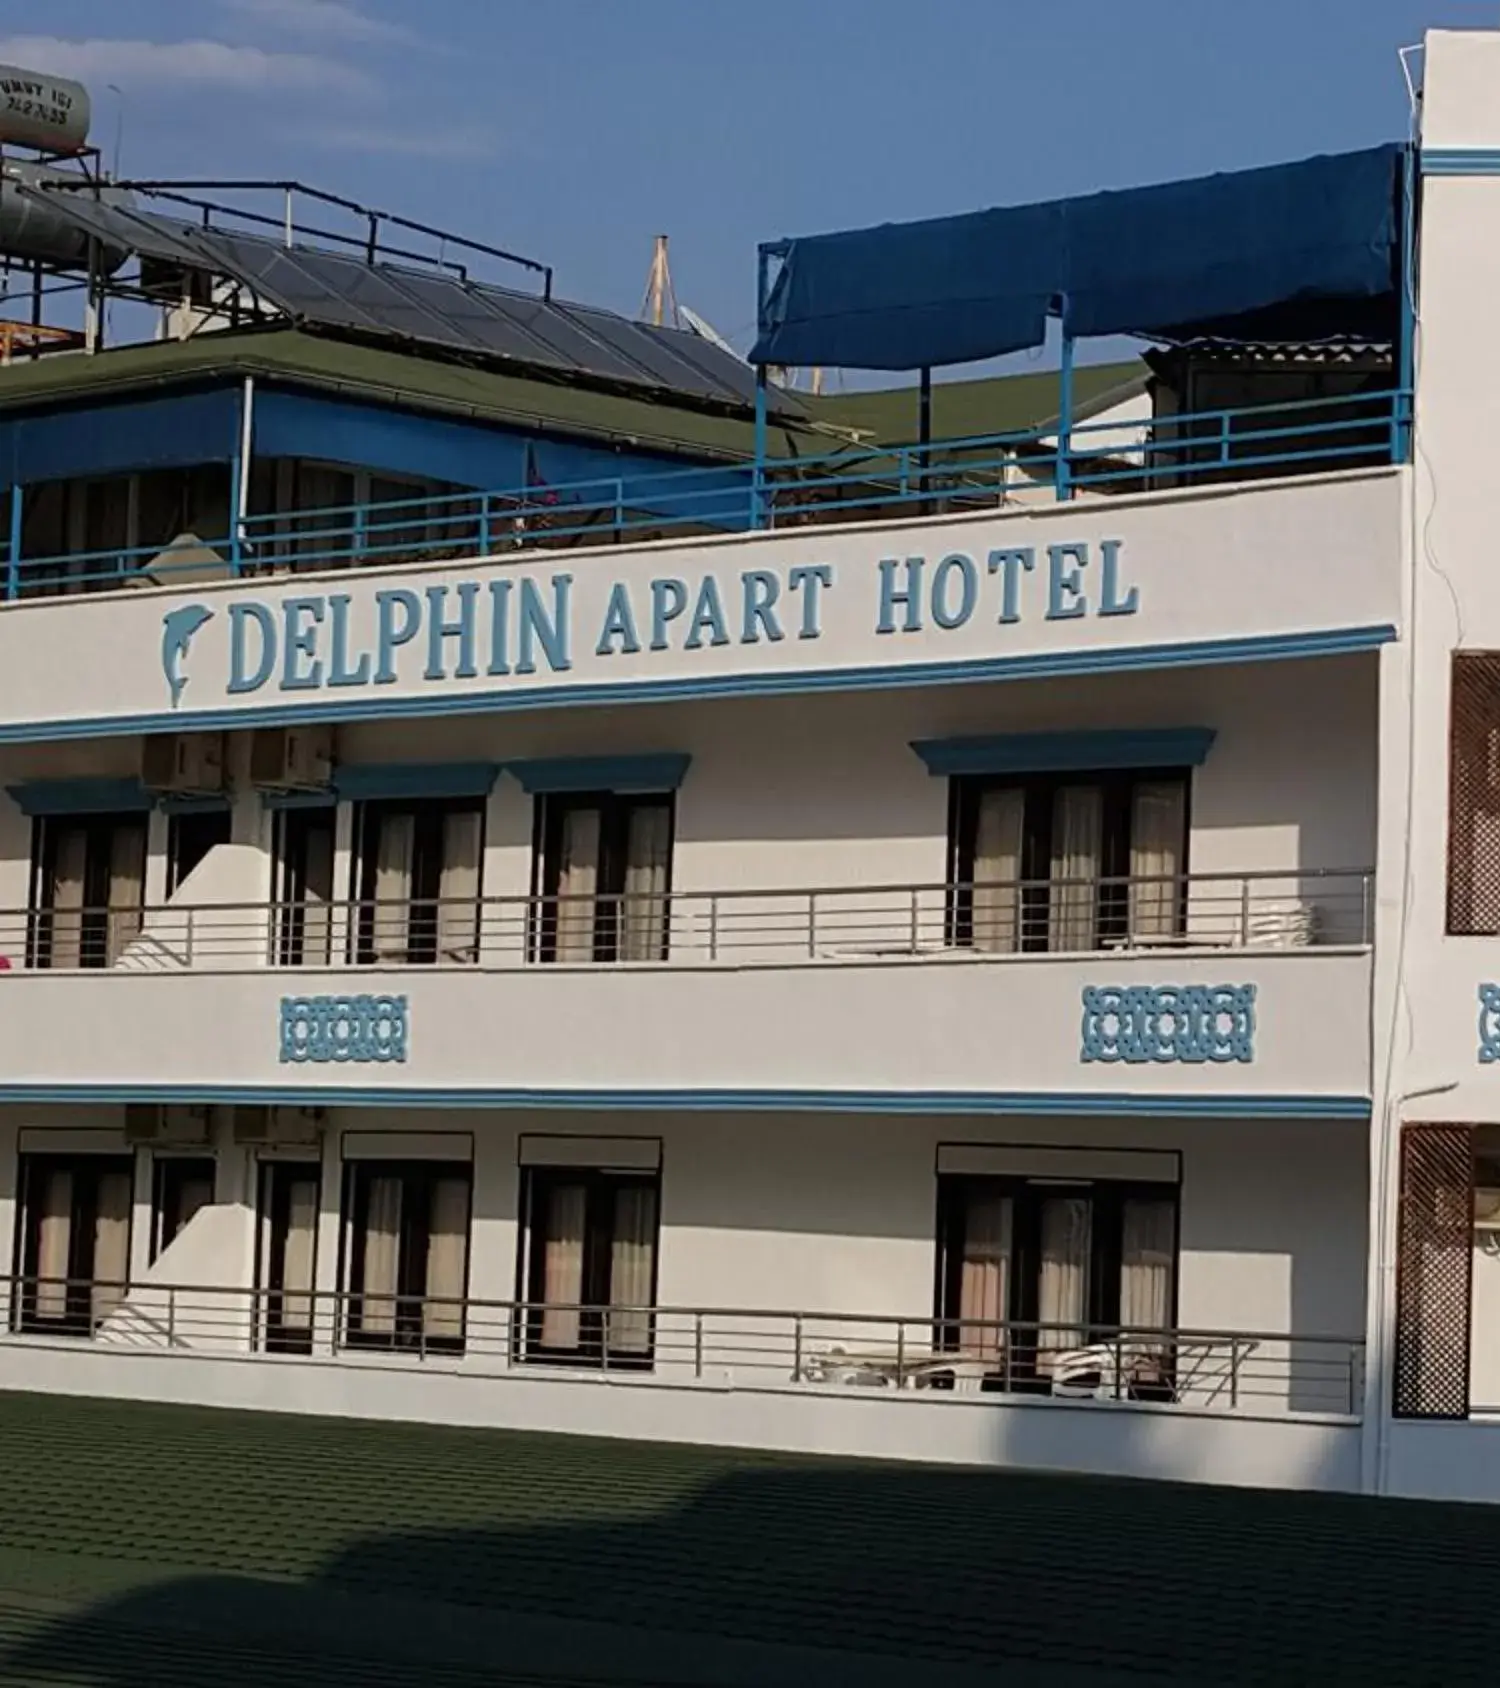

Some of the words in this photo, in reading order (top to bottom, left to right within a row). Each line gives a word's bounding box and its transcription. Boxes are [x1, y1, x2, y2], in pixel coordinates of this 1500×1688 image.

[226, 573, 573, 694] DELPHIN
[596, 564, 832, 655] APART
[876, 540, 1140, 634] HOTEL
